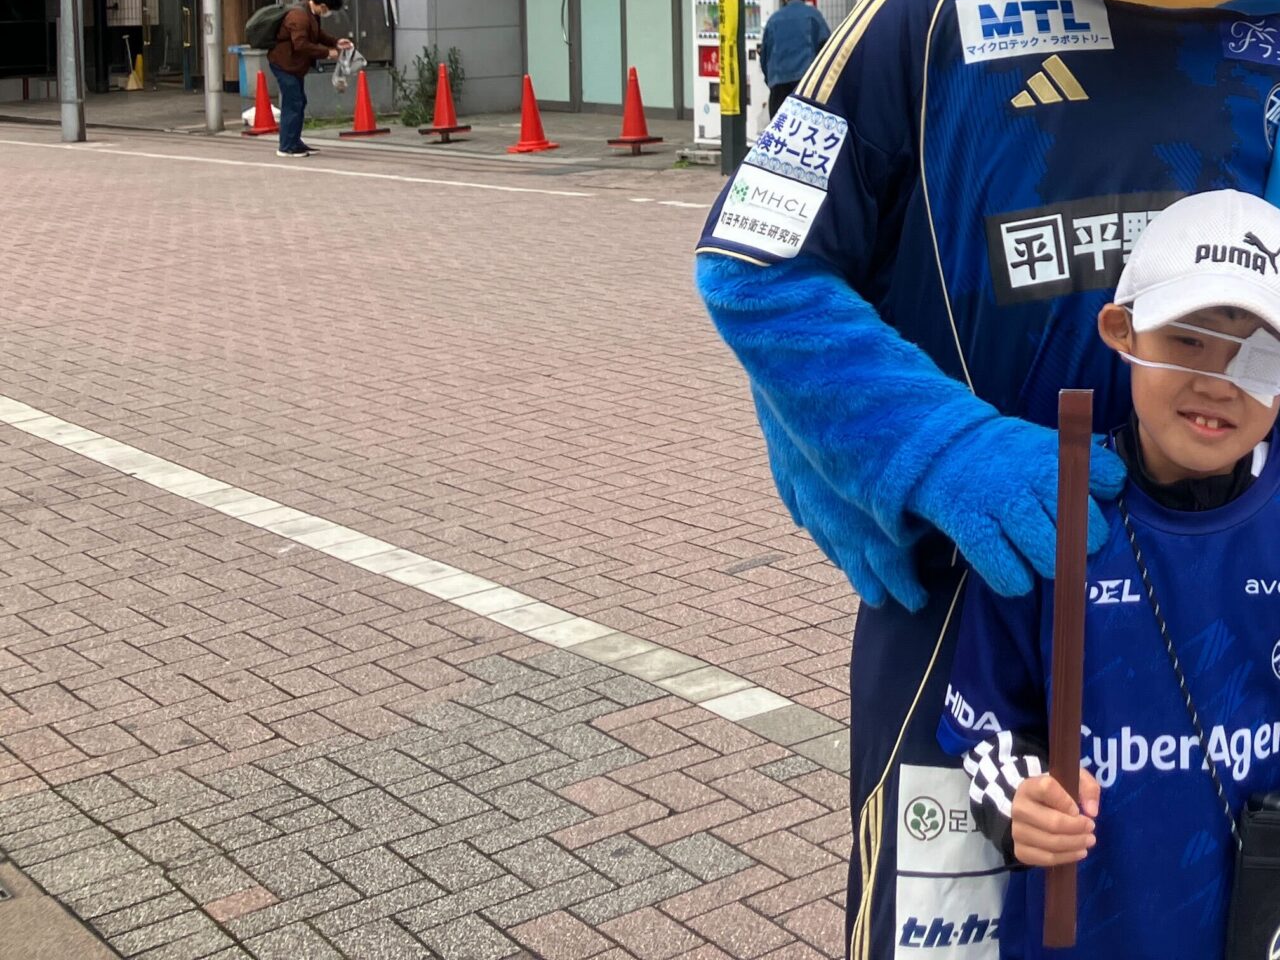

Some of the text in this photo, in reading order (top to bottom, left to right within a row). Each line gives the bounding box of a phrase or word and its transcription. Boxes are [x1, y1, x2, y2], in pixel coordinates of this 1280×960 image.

[978, 0, 1091, 40] MTL
[966, 35, 1110, 55] マイクロテック・ラボラトリー
[751, 186, 808, 219] MHCL
[1195, 244, 1267, 275] PUMA
